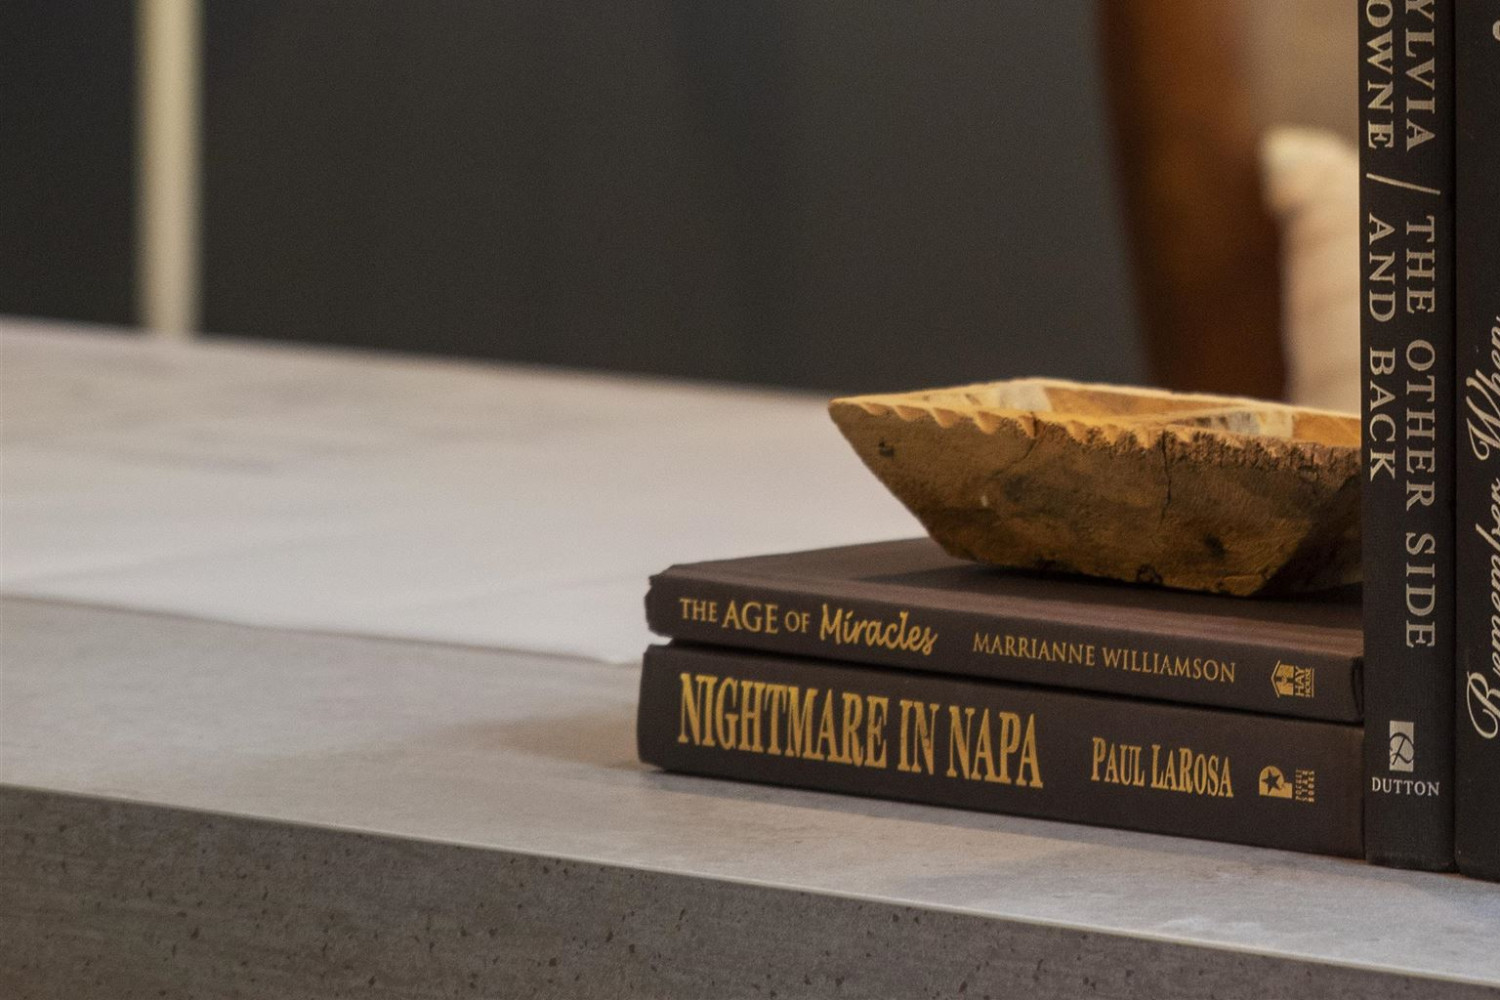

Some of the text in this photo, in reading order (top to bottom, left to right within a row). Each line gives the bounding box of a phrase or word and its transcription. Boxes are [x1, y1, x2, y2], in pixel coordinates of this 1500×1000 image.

[1368, 211, 1396, 482] AND BACK
[1405, 215, 1436, 648] THE OTHER SIDE
[679, 597, 938, 656] THE AGE OF Miracles
[972, 632, 1236, 684] MARRIANNE WILLIAMSON
[1295, 665, 1305, 697] HAY
[677, 671, 1044, 789] NIGHTMARE IN NAPA
[1090, 736, 1145, 787] PAUL
[1371, 776, 1440, 797] DUTTON
